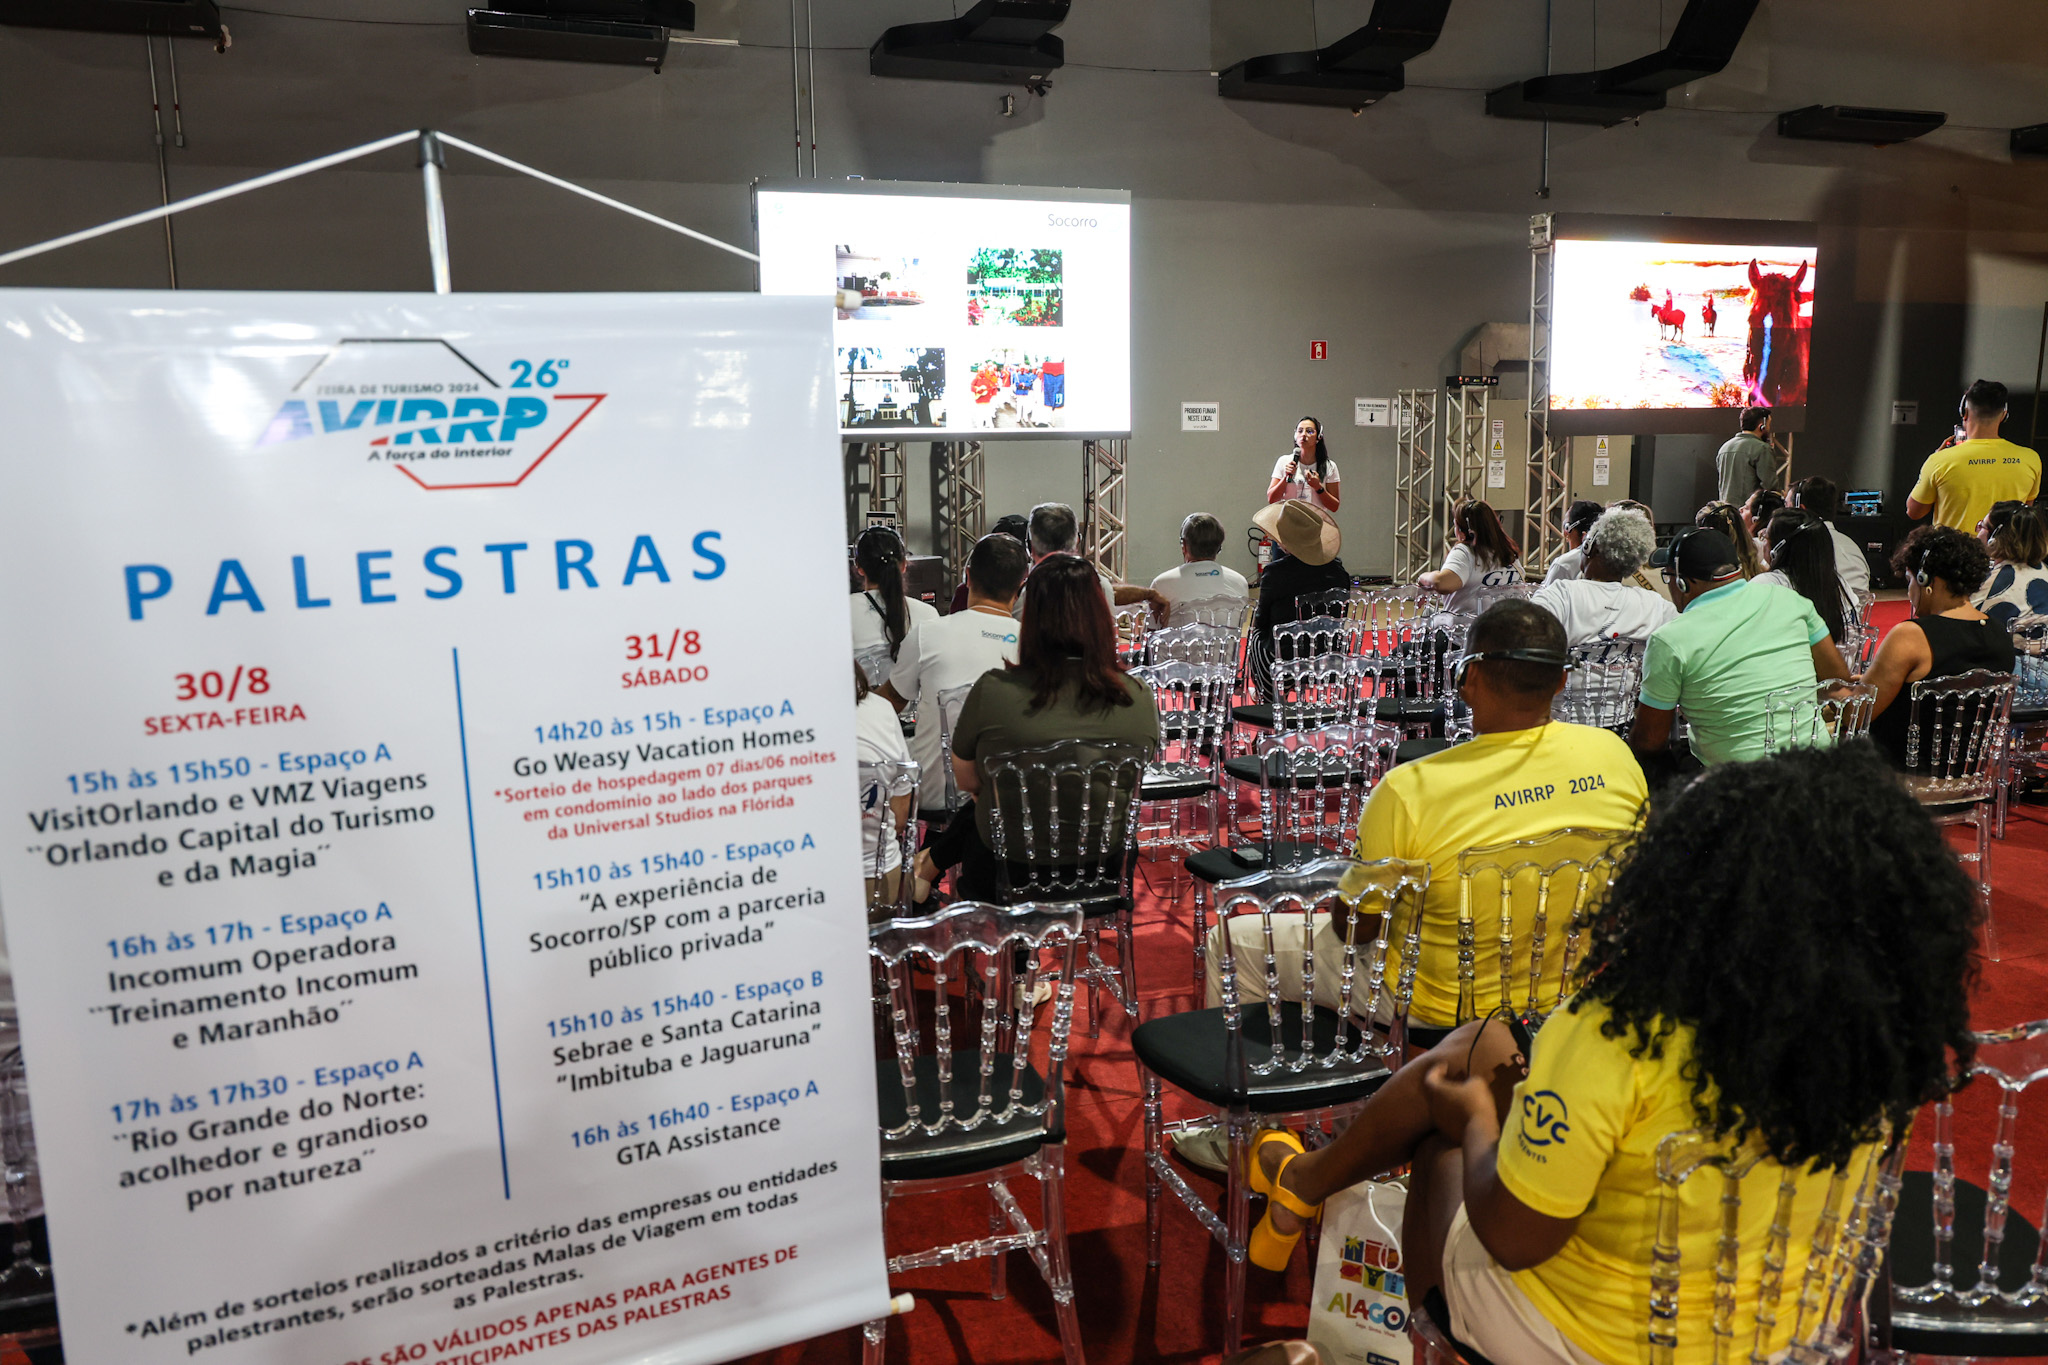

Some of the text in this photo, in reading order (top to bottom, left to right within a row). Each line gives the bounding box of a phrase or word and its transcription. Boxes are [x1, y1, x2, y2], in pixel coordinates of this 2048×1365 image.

[1048, 213, 1098, 228] Socorro
[317, 384, 479, 395] FEIRA DE TURISMO 2024
[254, 396, 548, 447] AVIRRP
[386, 447, 512, 461] força do interior
[123, 530, 727, 622] PALESTRAS
[1481, 570, 1522, 586] GT
[625, 628, 701, 662] 31/8
[175, 665, 271, 703] 30/8
[622, 665, 709, 689] SÁBADO
[144, 704, 306, 736] SEXTA-FEIRA
[535, 699, 794, 744] 14h20 às 15h Espaço A
[67, 743, 392, 794] 15h às 15h50 Espaço A
[513, 728, 815, 777] Go Weasy Vacation Homes
[572, 779, 592, 794] de
[598, 768, 701, 791] hospedagem
[706, 762, 724, 777] 07
[730, 755, 784, 774] dias/06
[790, 752, 836, 766] noites
[28, 774, 427, 833] VisitOrlando VMZ Viagens
[523, 775, 813, 822] em condomínio ao lado dos parques
[1494, 774, 1605, 810] AVIRRP 2024
[178, 817, 280, 852] Capital
[290, 814, 324, 836] do
[330, 805, 435, 831] Turismo
[548, 794, 794, 840] da Universal Studios na Flórida
[184, 860, 220, 884] da
[534, 833, 815, 890] 15h10 às 15h40 Espaço A
[615, 871, 744, 909] experiência
[751, 865, 777, 885] de
[107, 902, 392, 959] 16h às 17h Espaço A
[529, 887, 825, 953] Socorro/SP com parceria
[109, 935, 396, 992] Incomum Operadora
[296, 964, 418, 996] Incomum
[589, 944, 673, 978] público
[548, 970, 823, 1037] 15h10 às 15h40 Espaço B
[553, 1001, 821, 1066] Sebrae Santa Catarina
[112, 1051, 424, 1123] 17h às 17h30 Espaço A
[188, 1107, 290, 1141] Grande
[299, 1098, 333, 1121] do
[342, 1084, 424, 1112] Norte:
[572, 1080, 819, 1148] 16h às 16h40 Espaço A
[1524, 1093, 1570, 1144] CVC
[119, 1114, 428, 1188] acolhedor grandioso
[617, 1118, 780, 1165] GTA Assistance
[187, 1184, 233, 1212] por
[215, 1301, 245, 1320] de
[253, 1279, 348, 1312] sorteios
[355, 1249, 469, 1288] realizados
[494, 1225, 570, 1253] critério
[577, 1216, 612, 1234] das
[618, 1191, 712, 1224] empresas
[717, 1184, 742, 1199] ou
[748, 1161, 838, 1192] entidades
[187, 1192, 798, 1356] palestrantes, serão sorteadas Malas de Viagem em todas
[454, 1269, 583, 1310] as Palestras.
[380, 1245, 798, 1365] SÃO VÁLIDOS APENAS PARA AGENTES DE
[577, 1315, 618, 1338] DAS
[624, 1284, 731, 1325] PALESTRAS
